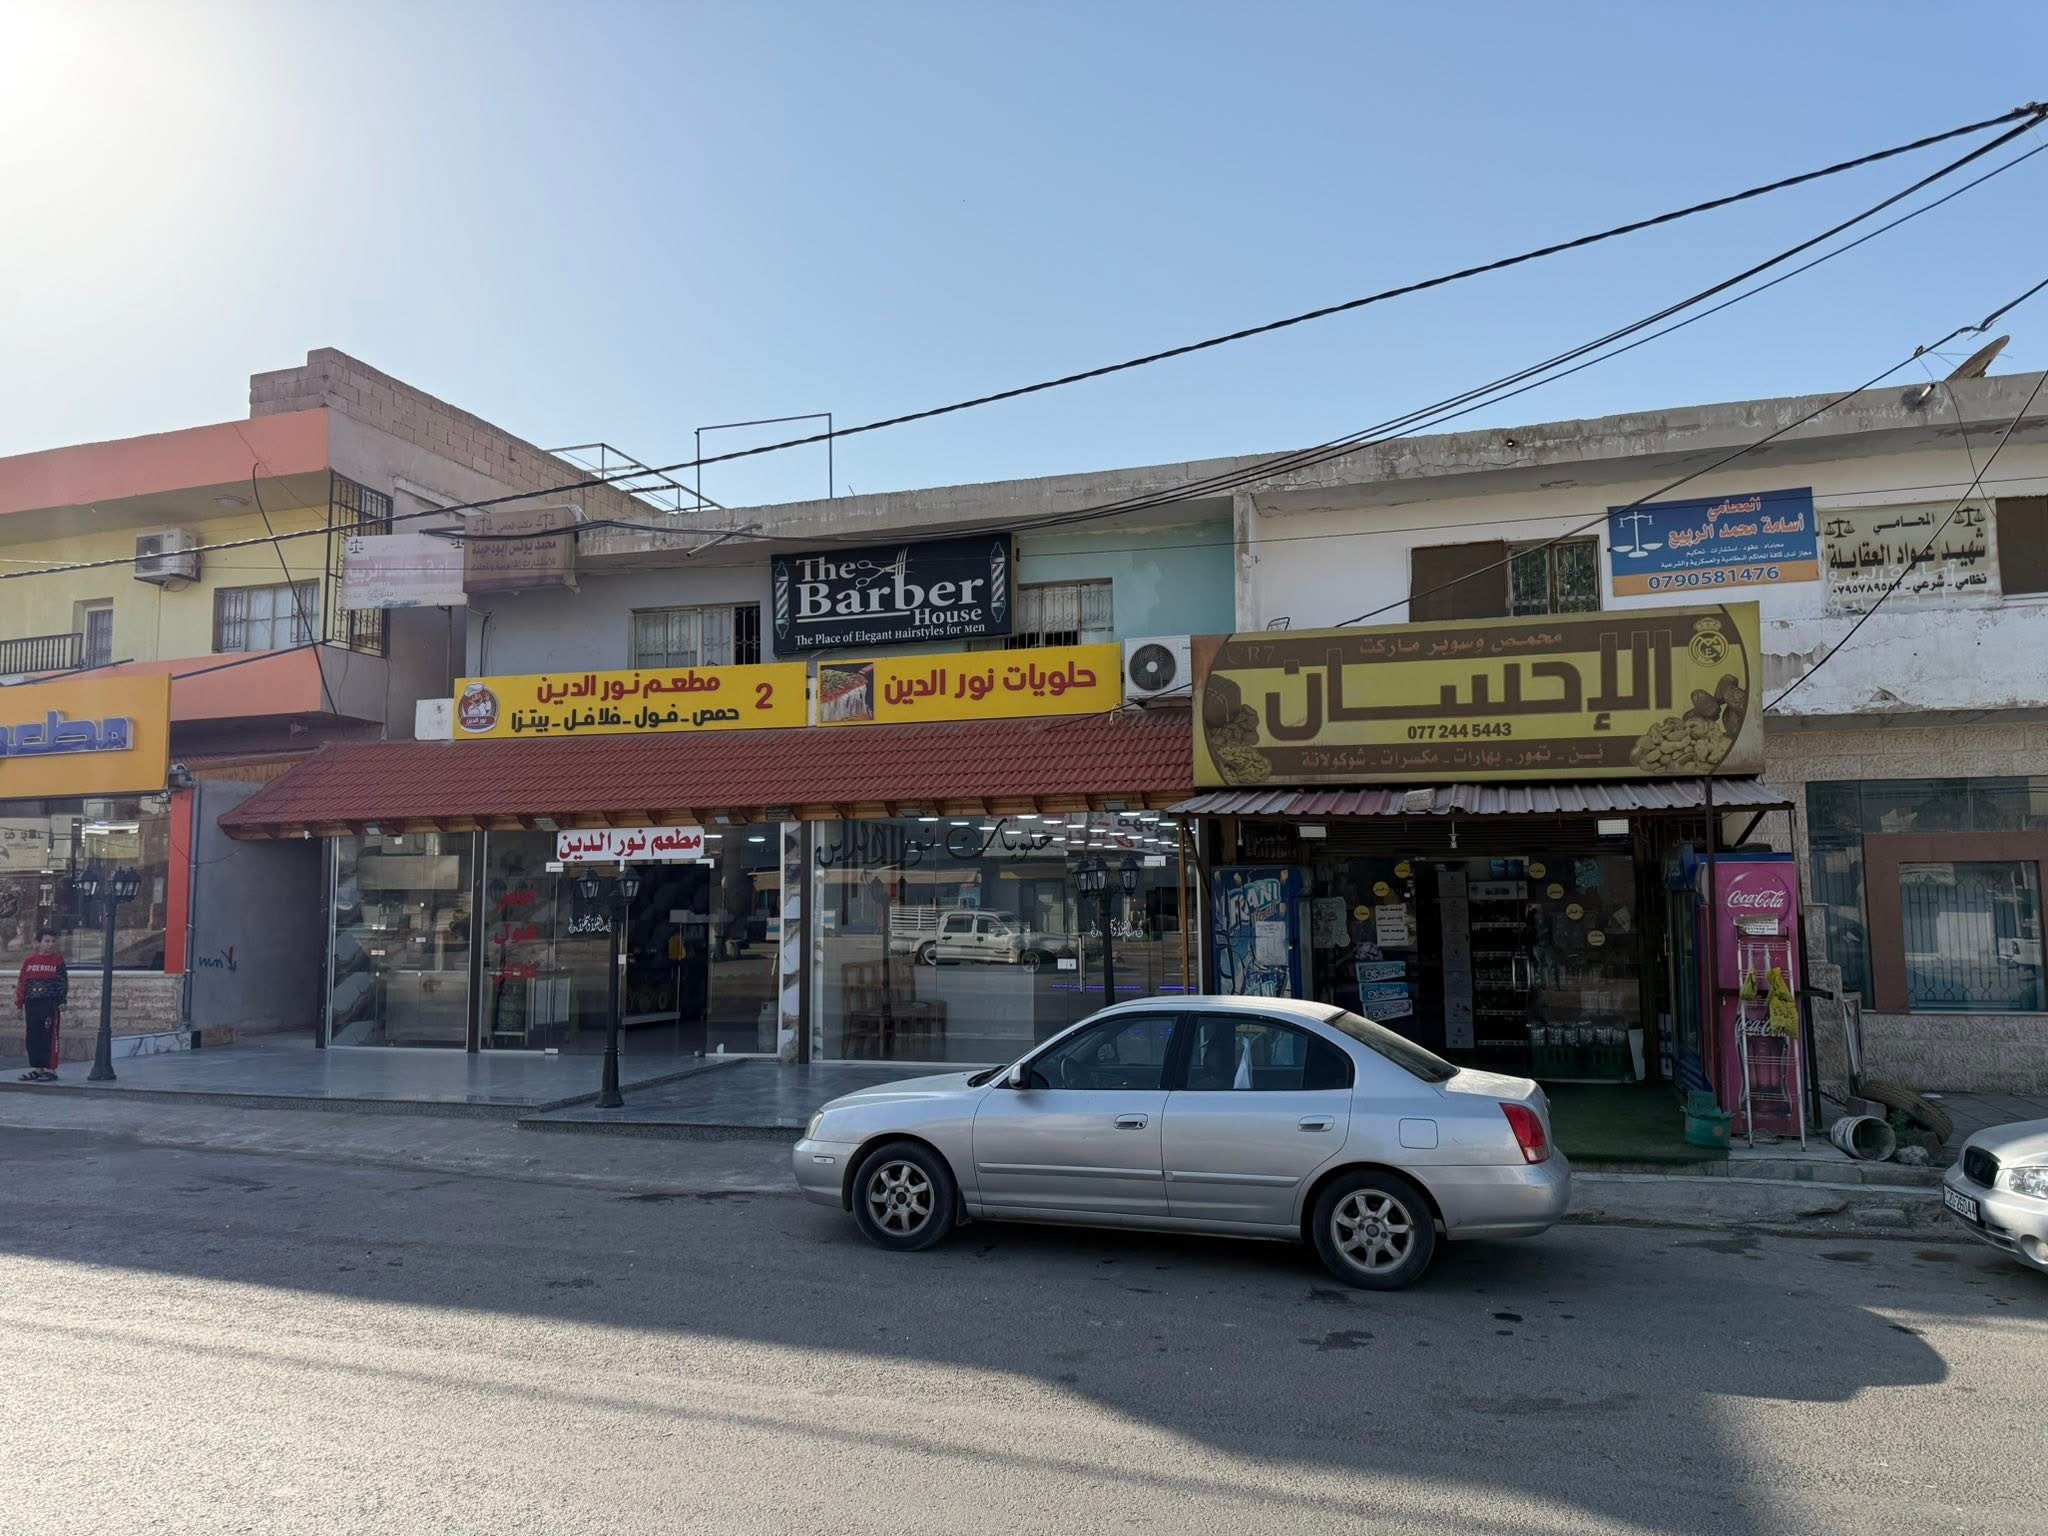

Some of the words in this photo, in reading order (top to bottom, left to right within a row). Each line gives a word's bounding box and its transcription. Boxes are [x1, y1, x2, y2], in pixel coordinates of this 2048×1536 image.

[1707, 496, 1761, 521] المحامي
[1719, 522, 1758, 539] محمد
[1761, 512, 1805, 534] أسامة
[1873, 512, 1935, 537] المحامي
[1668, 523, 1715, 549] الربيع
[795, 556, 857, 582] The
[1830, 541, 1891, 576] العقايلة
[795, 551, 985, 617] Barber
[1649, 566, 1779, 590] 0790581476
[1912, 574, 1945, 593] شرعي
[1955, 573, 1987, 591] نظامي
[913, 608, 983, 626] House
[795, 634, 814, 646] The
[815, 633, 841, 645] Place
[842, 631, 854, 643] of
[855, 629, 893, 644] Elegant
[895, 625, 944, 642] Hairstyles
[946, 624, 962, 635] for
[964, 623, 985, 634] Men
[1491, 632, 1562, 653] محمص
[1360, 638, 1420, 657] ماركت
[537, 674, 596, 705] الدين
[600, 673, 640, 702] نور
[643, 670, 720, 699] مطعم
[884, 668, 946, 705] الدين
[954, 668, 995, 701] نور
[1003, 661, 1097, 697] حلويات
[1265, 629, 1673, 742] الإحسان
[754, 682, 774, 710] 2
[511, 709, 550, 734] بيتزا
[563, 706, 621, 731] فلافل
[634, 704, 681, 728] فول
[692, 705, 740, 725] حمص
[1407, 725, 1434, 740] 077
[1439, 724, 1468, 739] 244
[1471, 722, 1512, 738] 5443
[1301, 748, 1366, 772] شوكولاتة
[1381, 747, 1439, 770] مكسرات
[1453, 748, 1501, 769] بهارات
[1513, 744, 1550, 767] تمور
[559, 832, 611, 860] الدين
[614, 829, 646, 857] نور
[652, 828, 701, 857] مطعم
[1728, 889, 1785, 909] Coca-Cola
